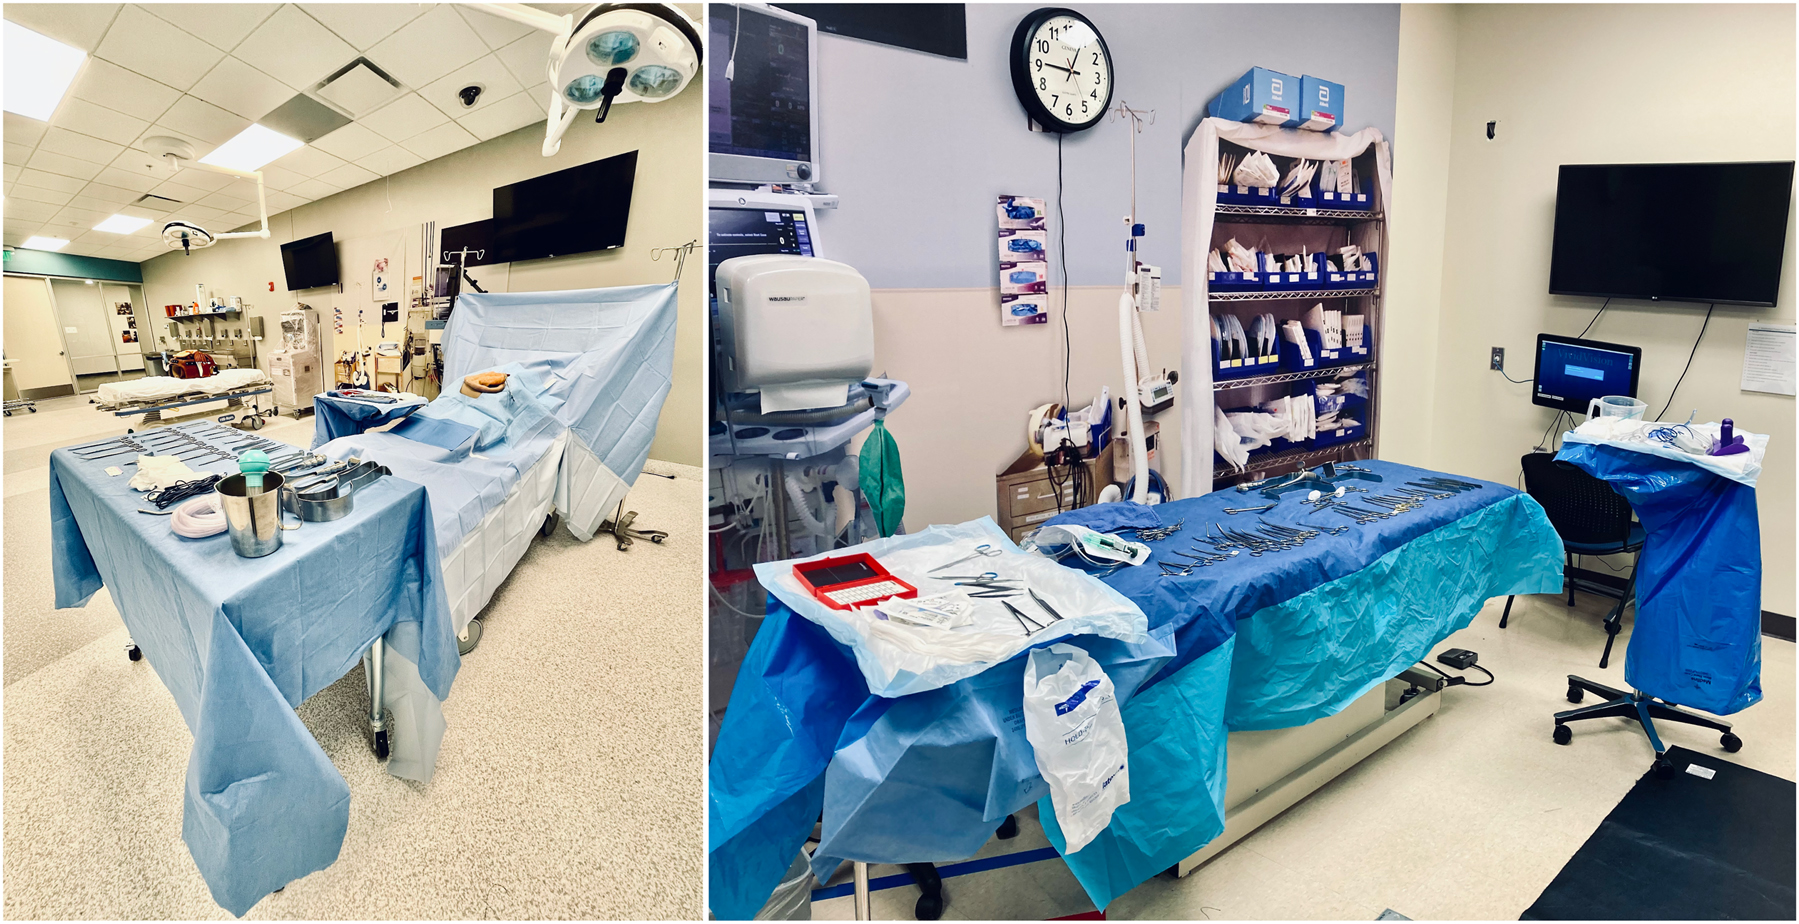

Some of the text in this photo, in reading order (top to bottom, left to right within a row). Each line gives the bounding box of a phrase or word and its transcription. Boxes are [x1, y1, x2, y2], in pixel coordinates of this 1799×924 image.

[1048, 26, 1059, 41] 11
[1036, 39, 1050, 54] 10
[1035, 58, 1043, 72] 9
[1093, 52, 1099, 66] 2
[1039, 77, 1047, 91] 8
[1095, 72, 1101, 85] 3
[1051, 94, 1059, 107] 7
[1090, 88, 1098, 101] 4
[1065, 103, 1073, 116] 6
[1081, 100, 1088, 113] 5
